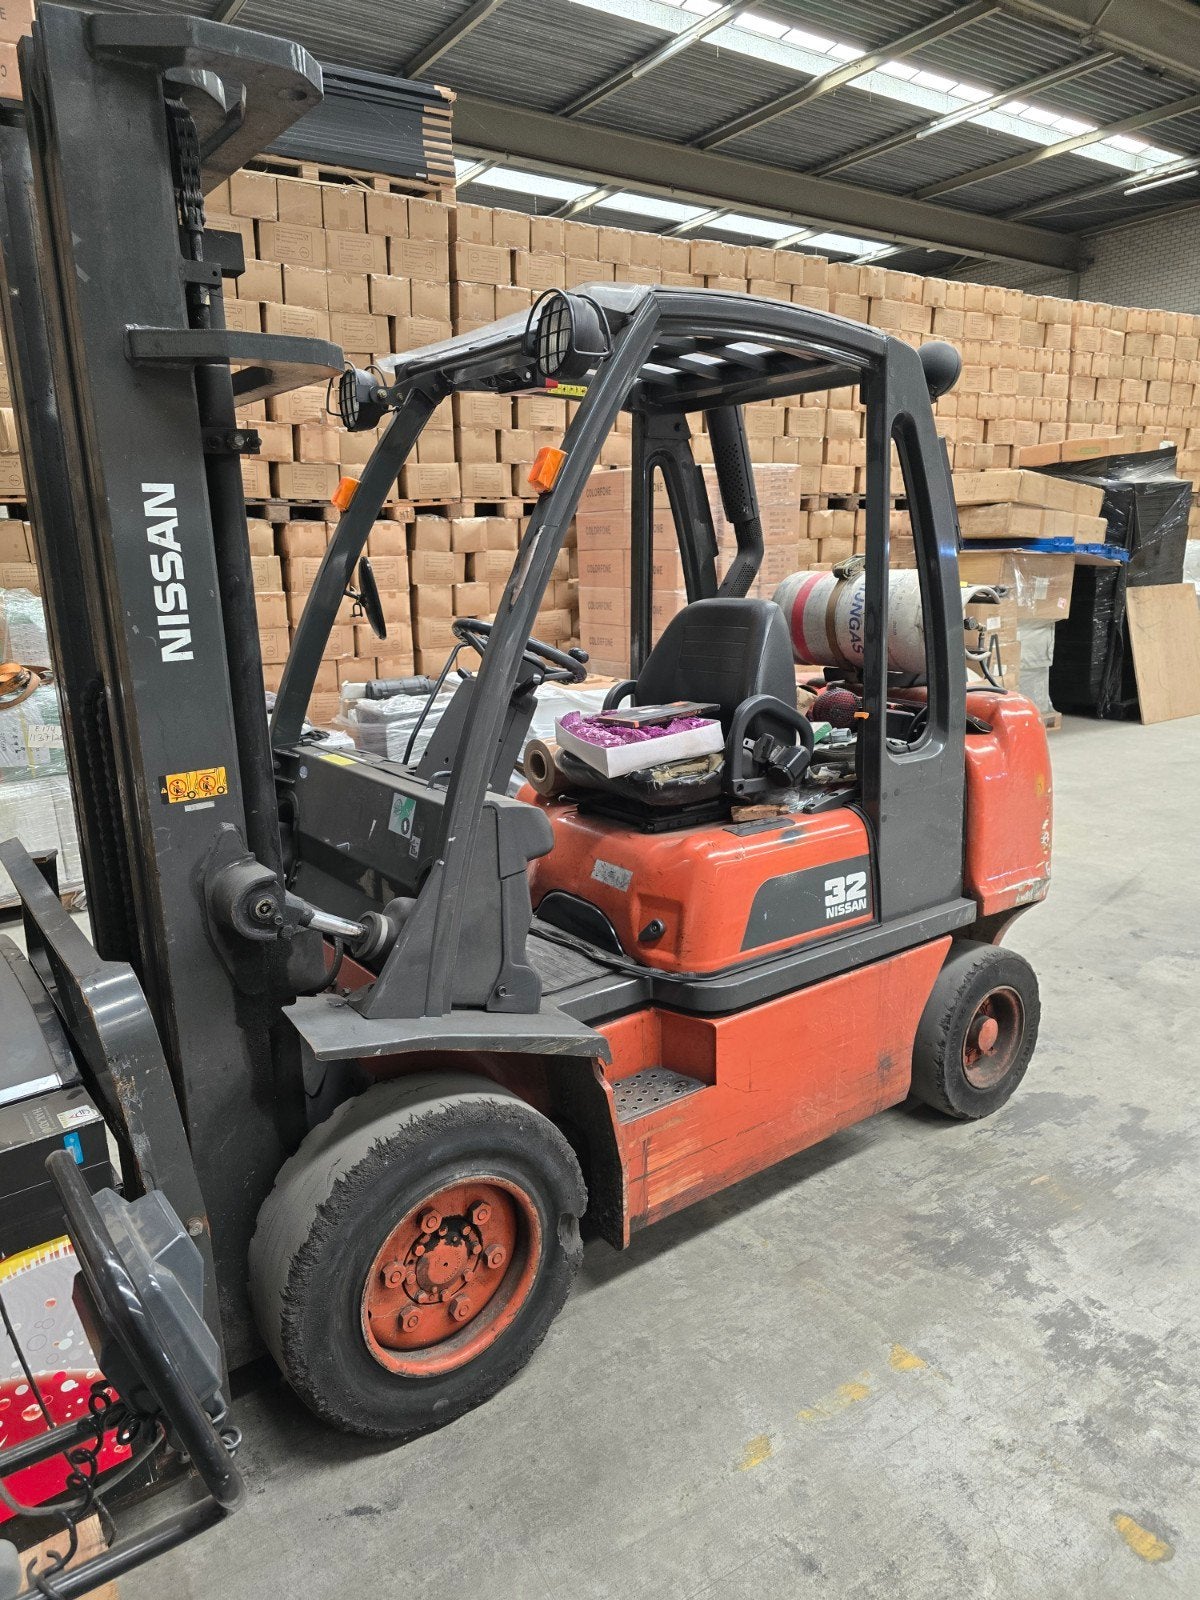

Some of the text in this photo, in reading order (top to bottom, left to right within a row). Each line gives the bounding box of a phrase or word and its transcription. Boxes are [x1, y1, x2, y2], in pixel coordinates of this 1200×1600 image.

[141, 483, 194, 662] NISSAN
[825, 871, 867, 907] 32
[826, 898, 867, 919] NISSAN
